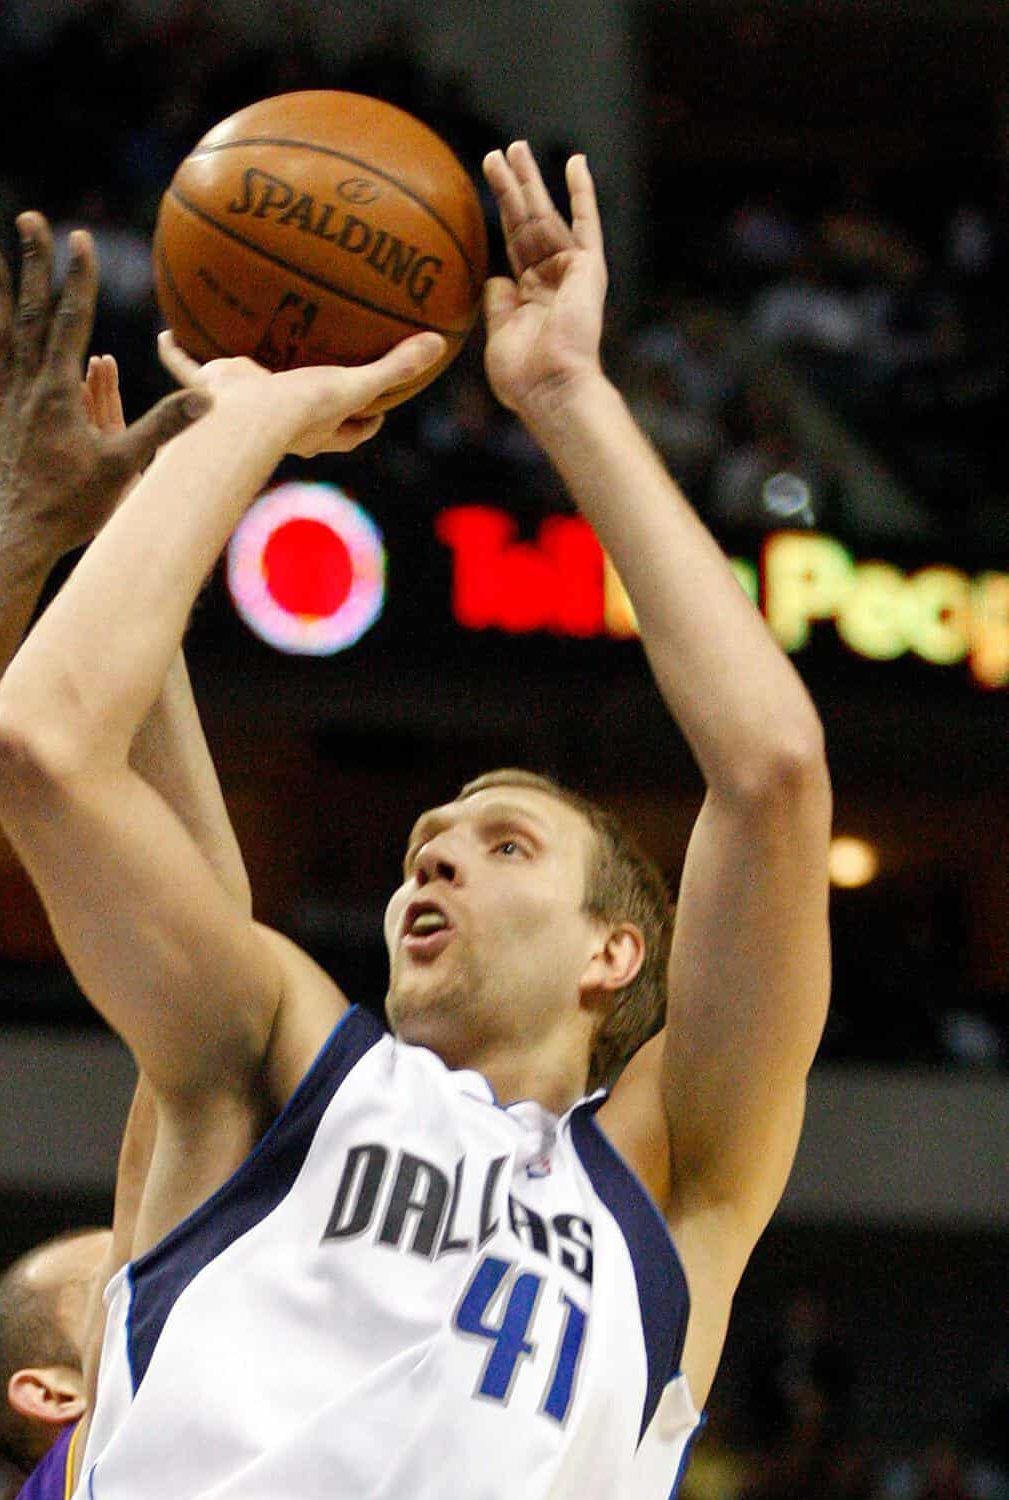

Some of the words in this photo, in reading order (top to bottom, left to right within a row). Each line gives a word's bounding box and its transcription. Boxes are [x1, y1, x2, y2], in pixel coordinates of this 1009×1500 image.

[229, 167, 444, 305] SPALDING
[319, 1144, 594, 1288] DALLAS
[451, 1252, 590, 1432] 41
